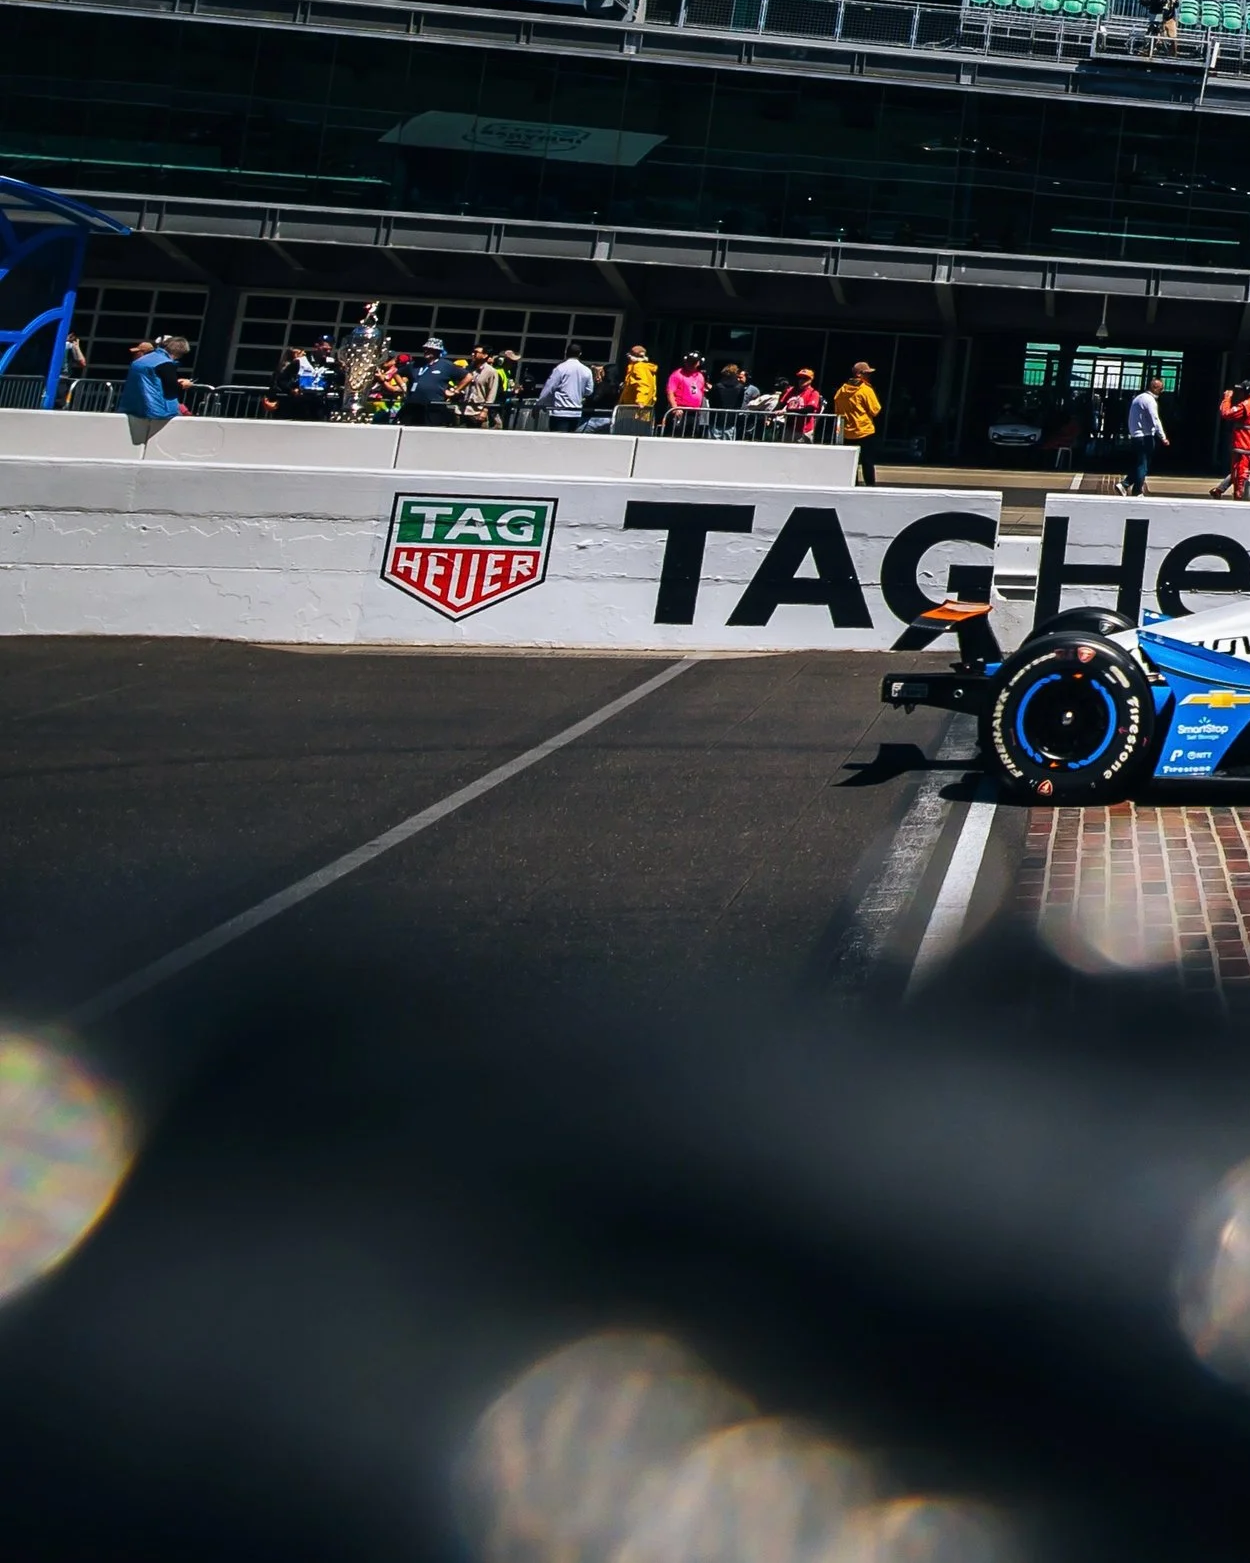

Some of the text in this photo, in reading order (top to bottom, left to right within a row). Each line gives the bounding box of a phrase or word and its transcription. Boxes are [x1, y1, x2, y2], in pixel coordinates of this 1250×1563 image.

[408, 505, 537, 543] TAG
[398, 550, 535, 608] HEUER
[1103, 696, 1140, 779] Firestone
[1177, 724, 1229, 734] SmartStop
